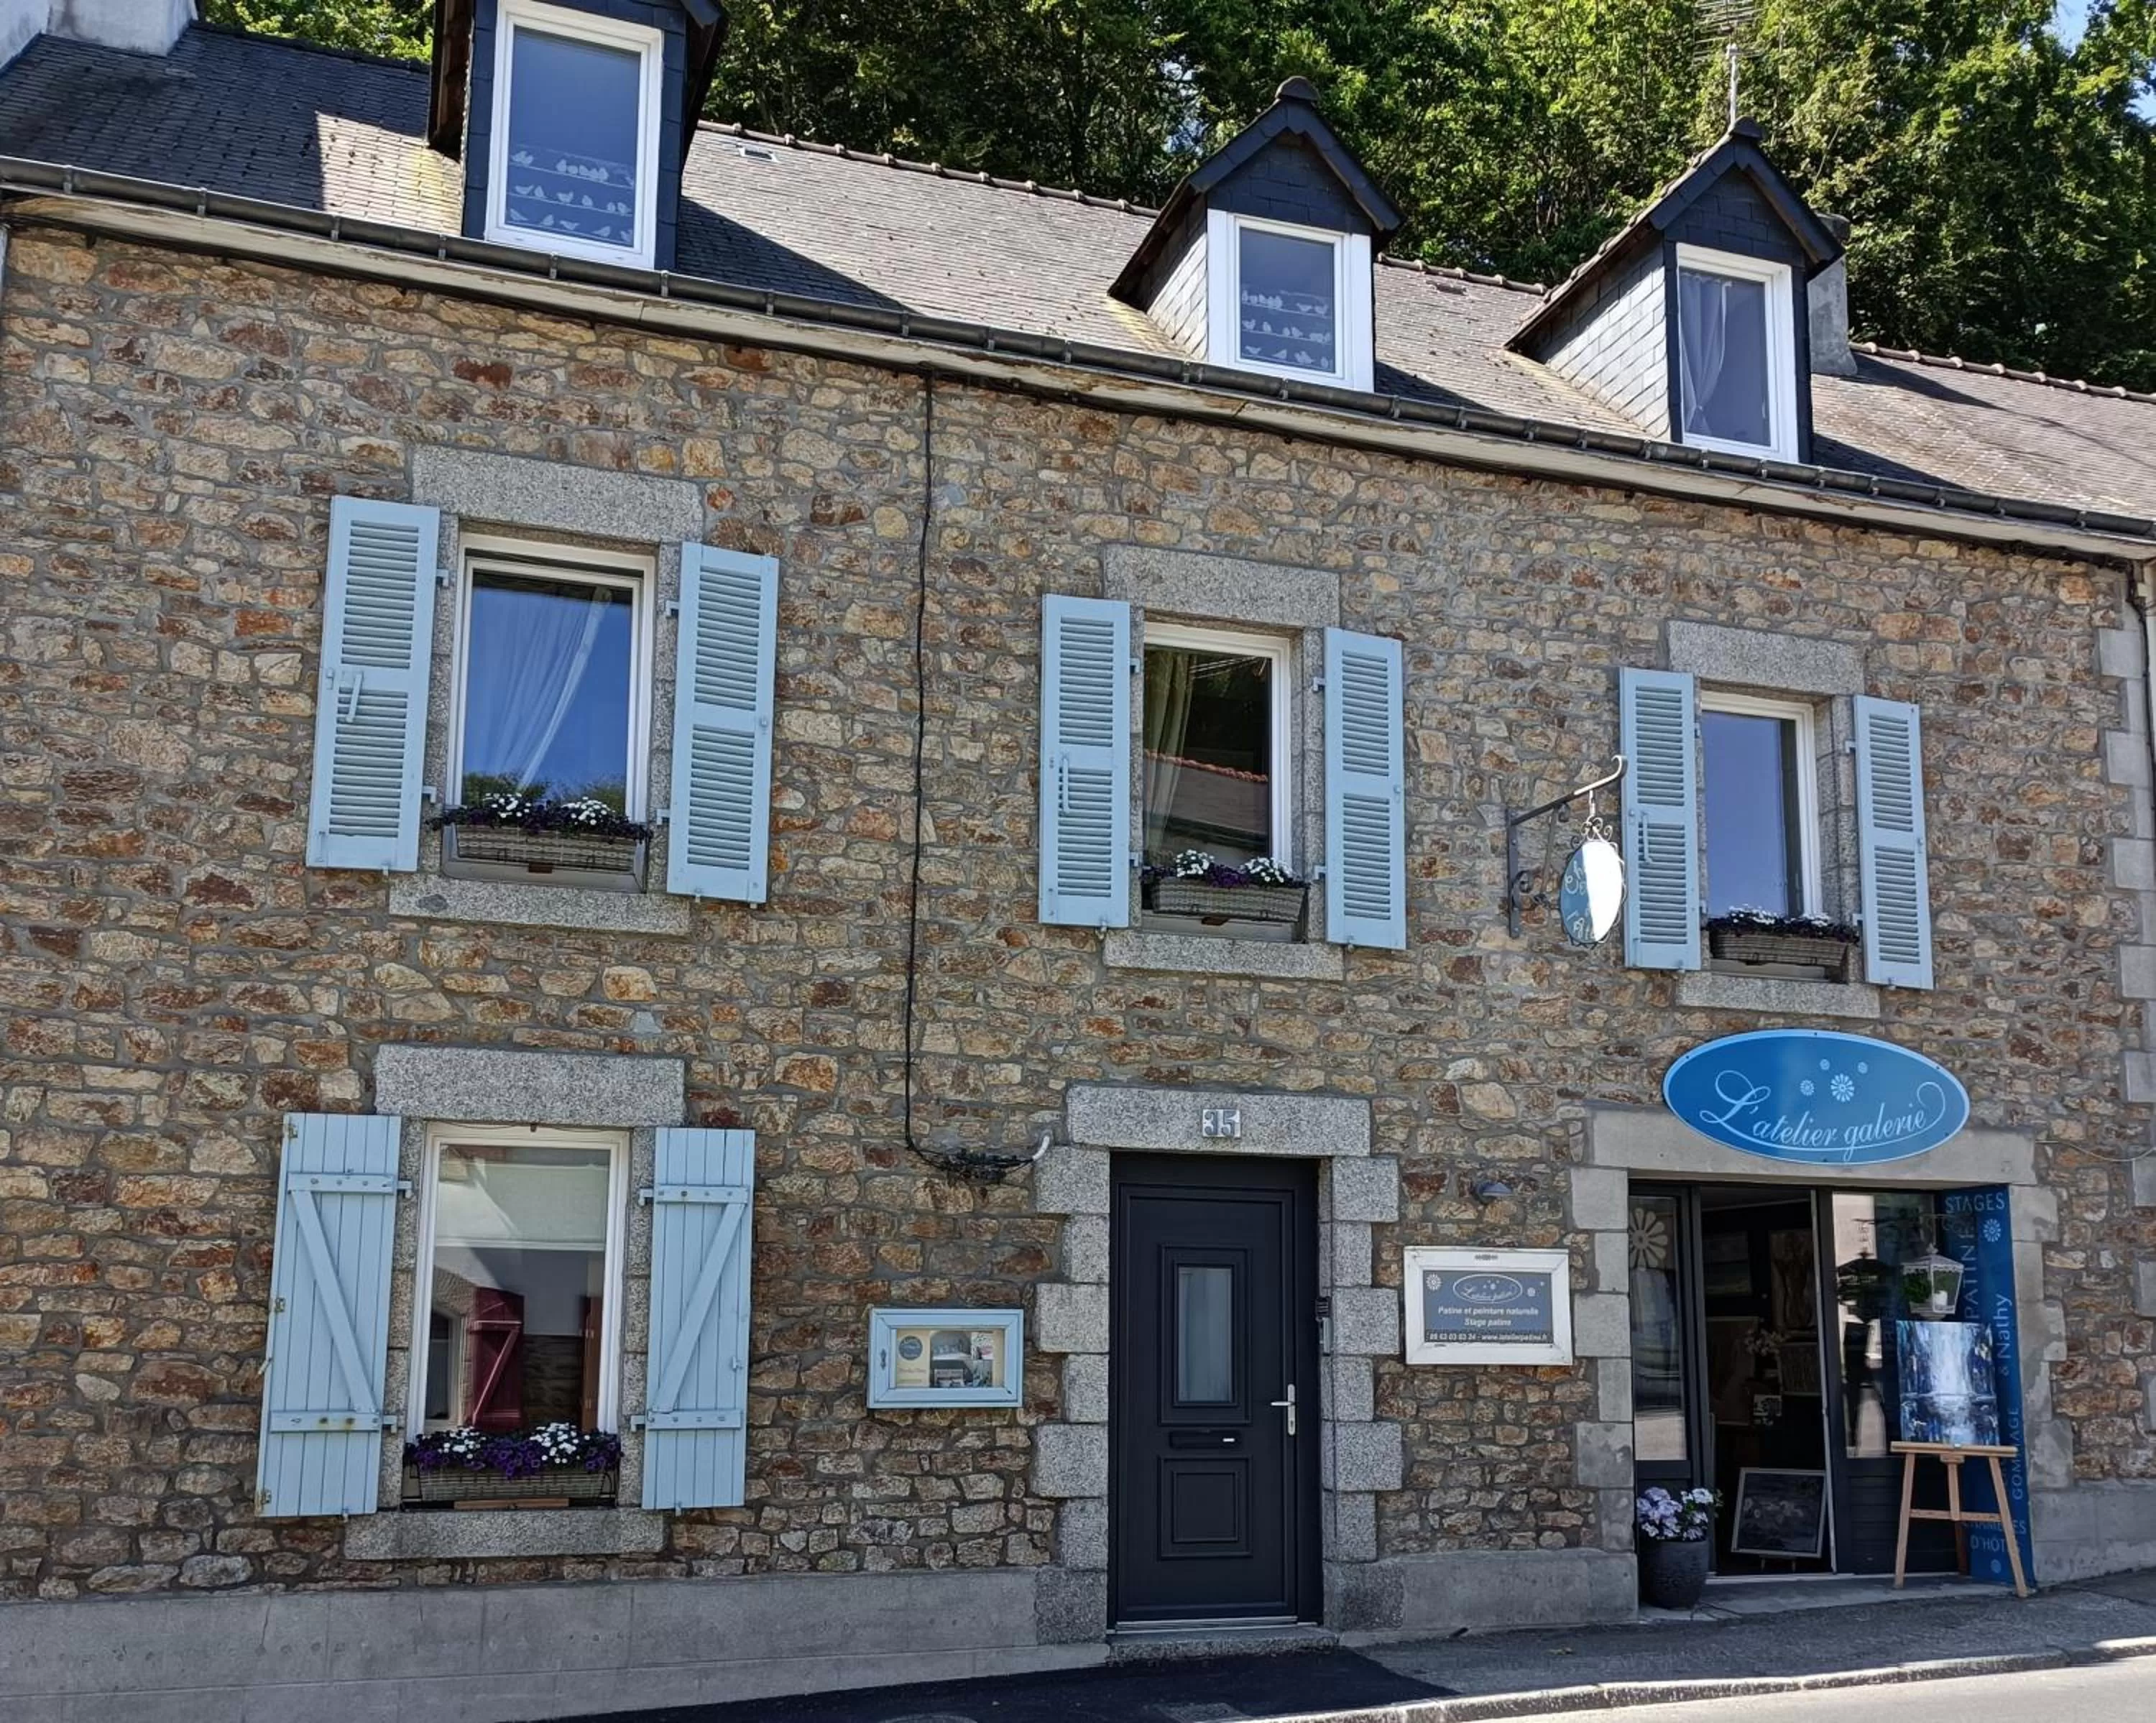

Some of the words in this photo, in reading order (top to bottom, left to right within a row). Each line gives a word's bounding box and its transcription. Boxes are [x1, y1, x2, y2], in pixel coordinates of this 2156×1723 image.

[1204, 1109, 1237, 1137] 35
[1699, 1069, 1838, 1148] L'atelier
[1843, 1098, 1930, 1161] galerie
[1944, 1192, 2005, 1214] STAGES
[1991, 1293, 2013, 1359] Nathy
[2007, 1407, 2024, 1500] GOMAGE
